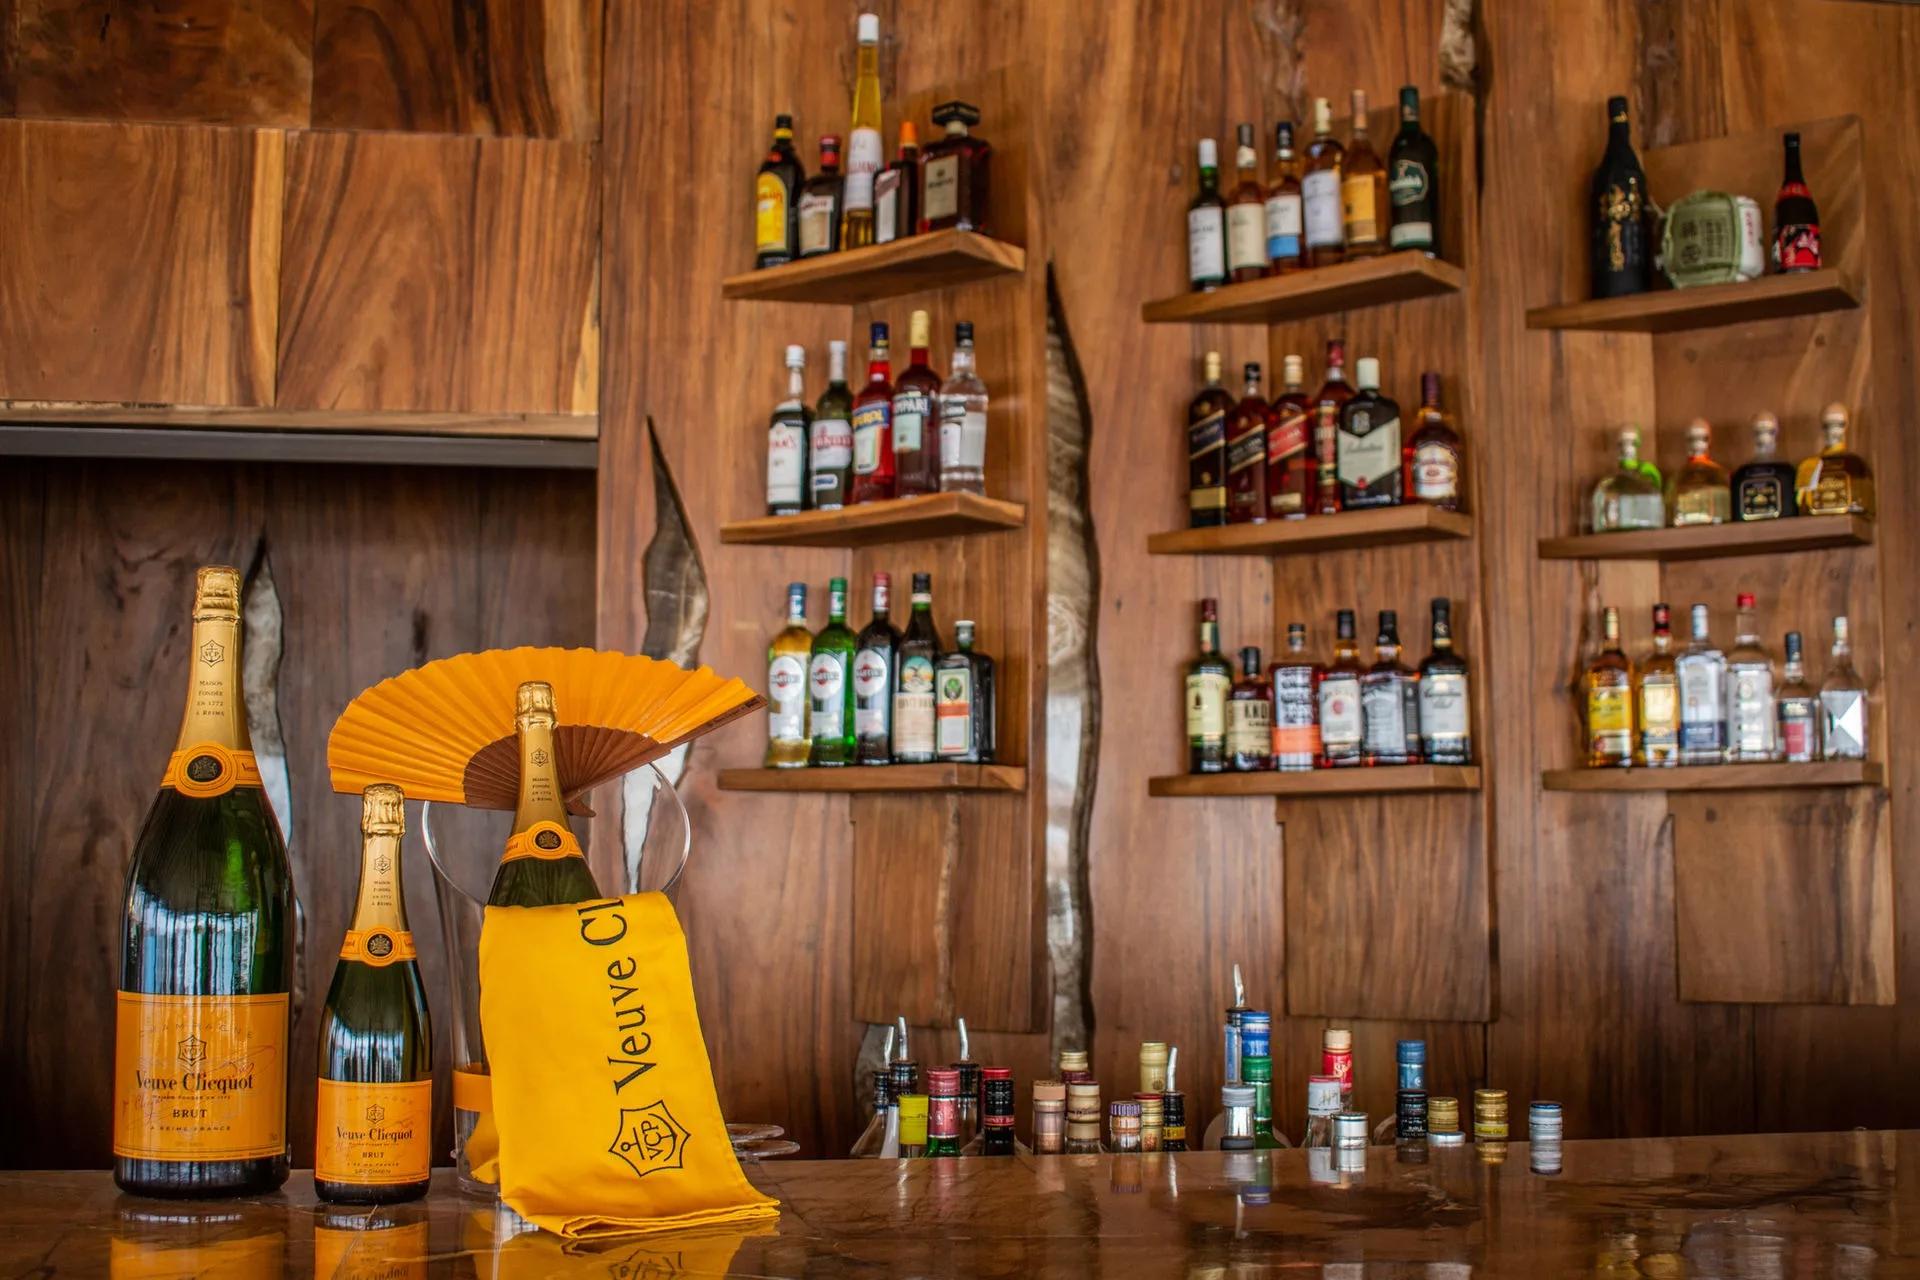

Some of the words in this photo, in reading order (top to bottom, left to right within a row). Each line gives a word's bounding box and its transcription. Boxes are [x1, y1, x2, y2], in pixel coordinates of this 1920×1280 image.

[607, 955, 657, 1095] Veuve
[136, 1070, 177, 1091] Veuve
[182, 1071, 254, 1094] Clicquot
[172, 1109, 208, 1118] BRUT
[336, 1125, 366, 1140] Veuve
[368, 1127, 413, 1143] Clicquot
[639, 1119, 664, 1161] VCP
[362, 1151, 385, 1159] BRUT
